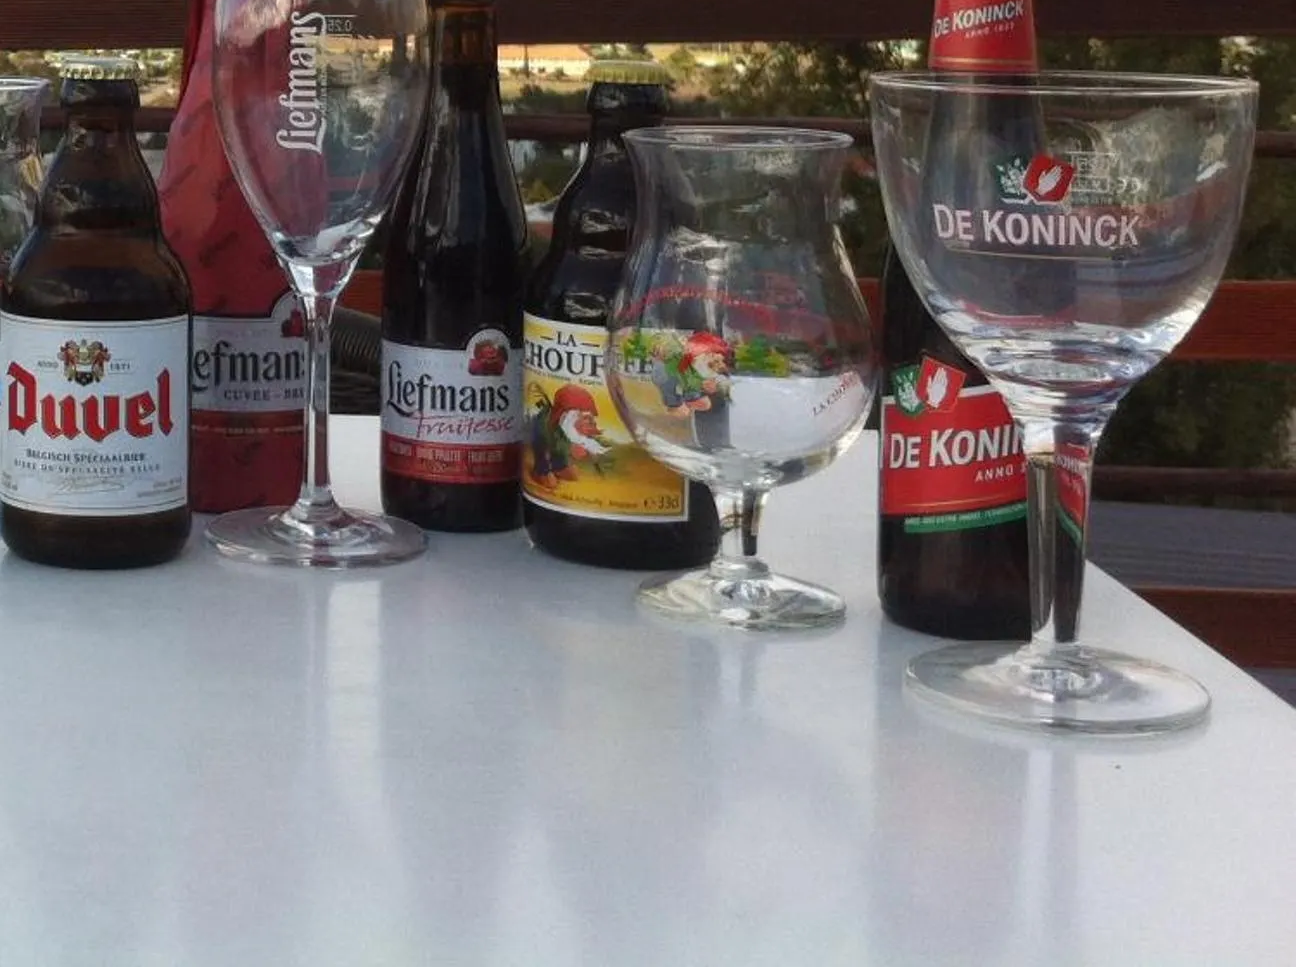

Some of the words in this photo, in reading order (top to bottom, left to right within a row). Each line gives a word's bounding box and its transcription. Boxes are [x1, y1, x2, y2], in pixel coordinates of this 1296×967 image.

[935, 17, 950, 38] DE
[952, 0, 1023, 31] KONINCK
[275, 10, 326, 155] Liefmans
[933, 204, 974, 242] DE
[982, 209, 1139, 246] KONINCK
[556, 331, 577, 347] LA
[7, 361, 174, 443] Duvel
[387, 360, 510, 418] Liefmans
[889, 433, 921, 469] DE
[929, 422, 1025, 467] KONIN
[975, 463, 1014, 483] ANNO
